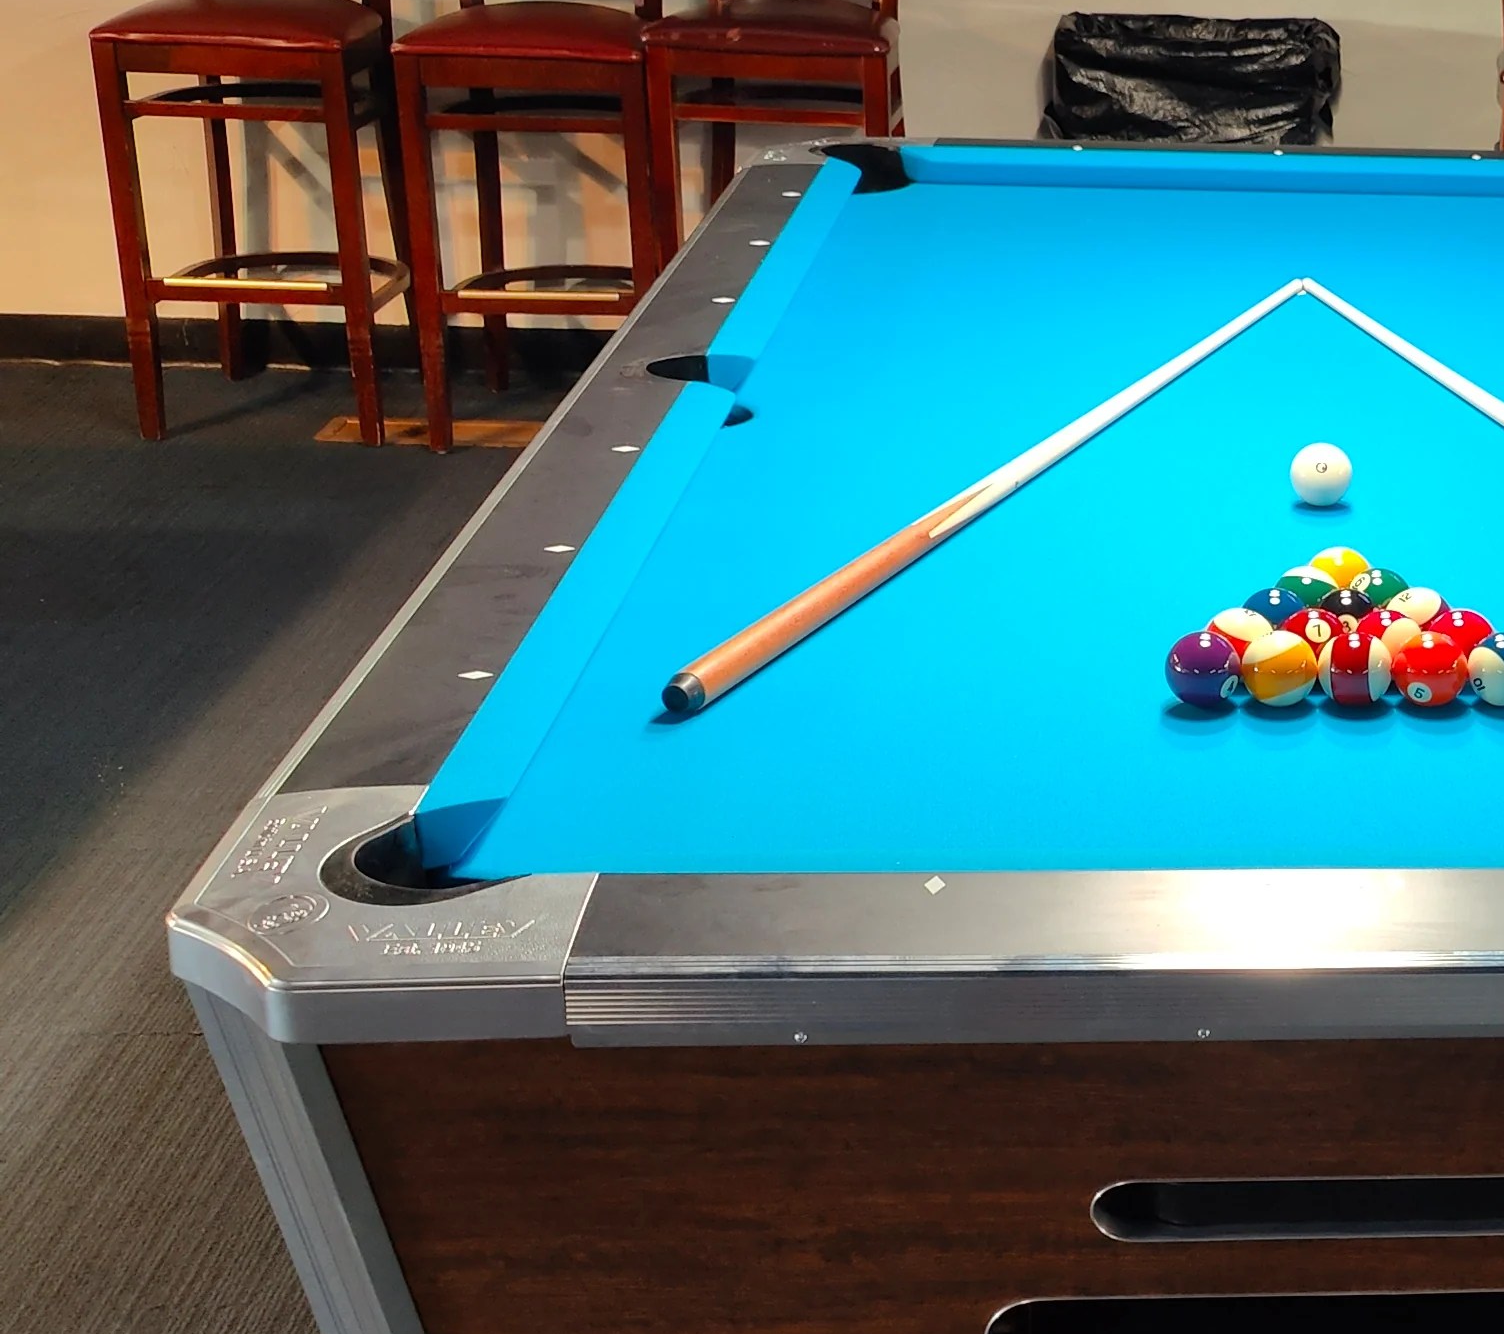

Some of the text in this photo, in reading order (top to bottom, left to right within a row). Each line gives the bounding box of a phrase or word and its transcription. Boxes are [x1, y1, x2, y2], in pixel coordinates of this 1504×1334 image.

[1312, 624, 1322, 638] 7
[1473, 677, 1486, 692] 10
[1413, 687, 1426, 700] 5
